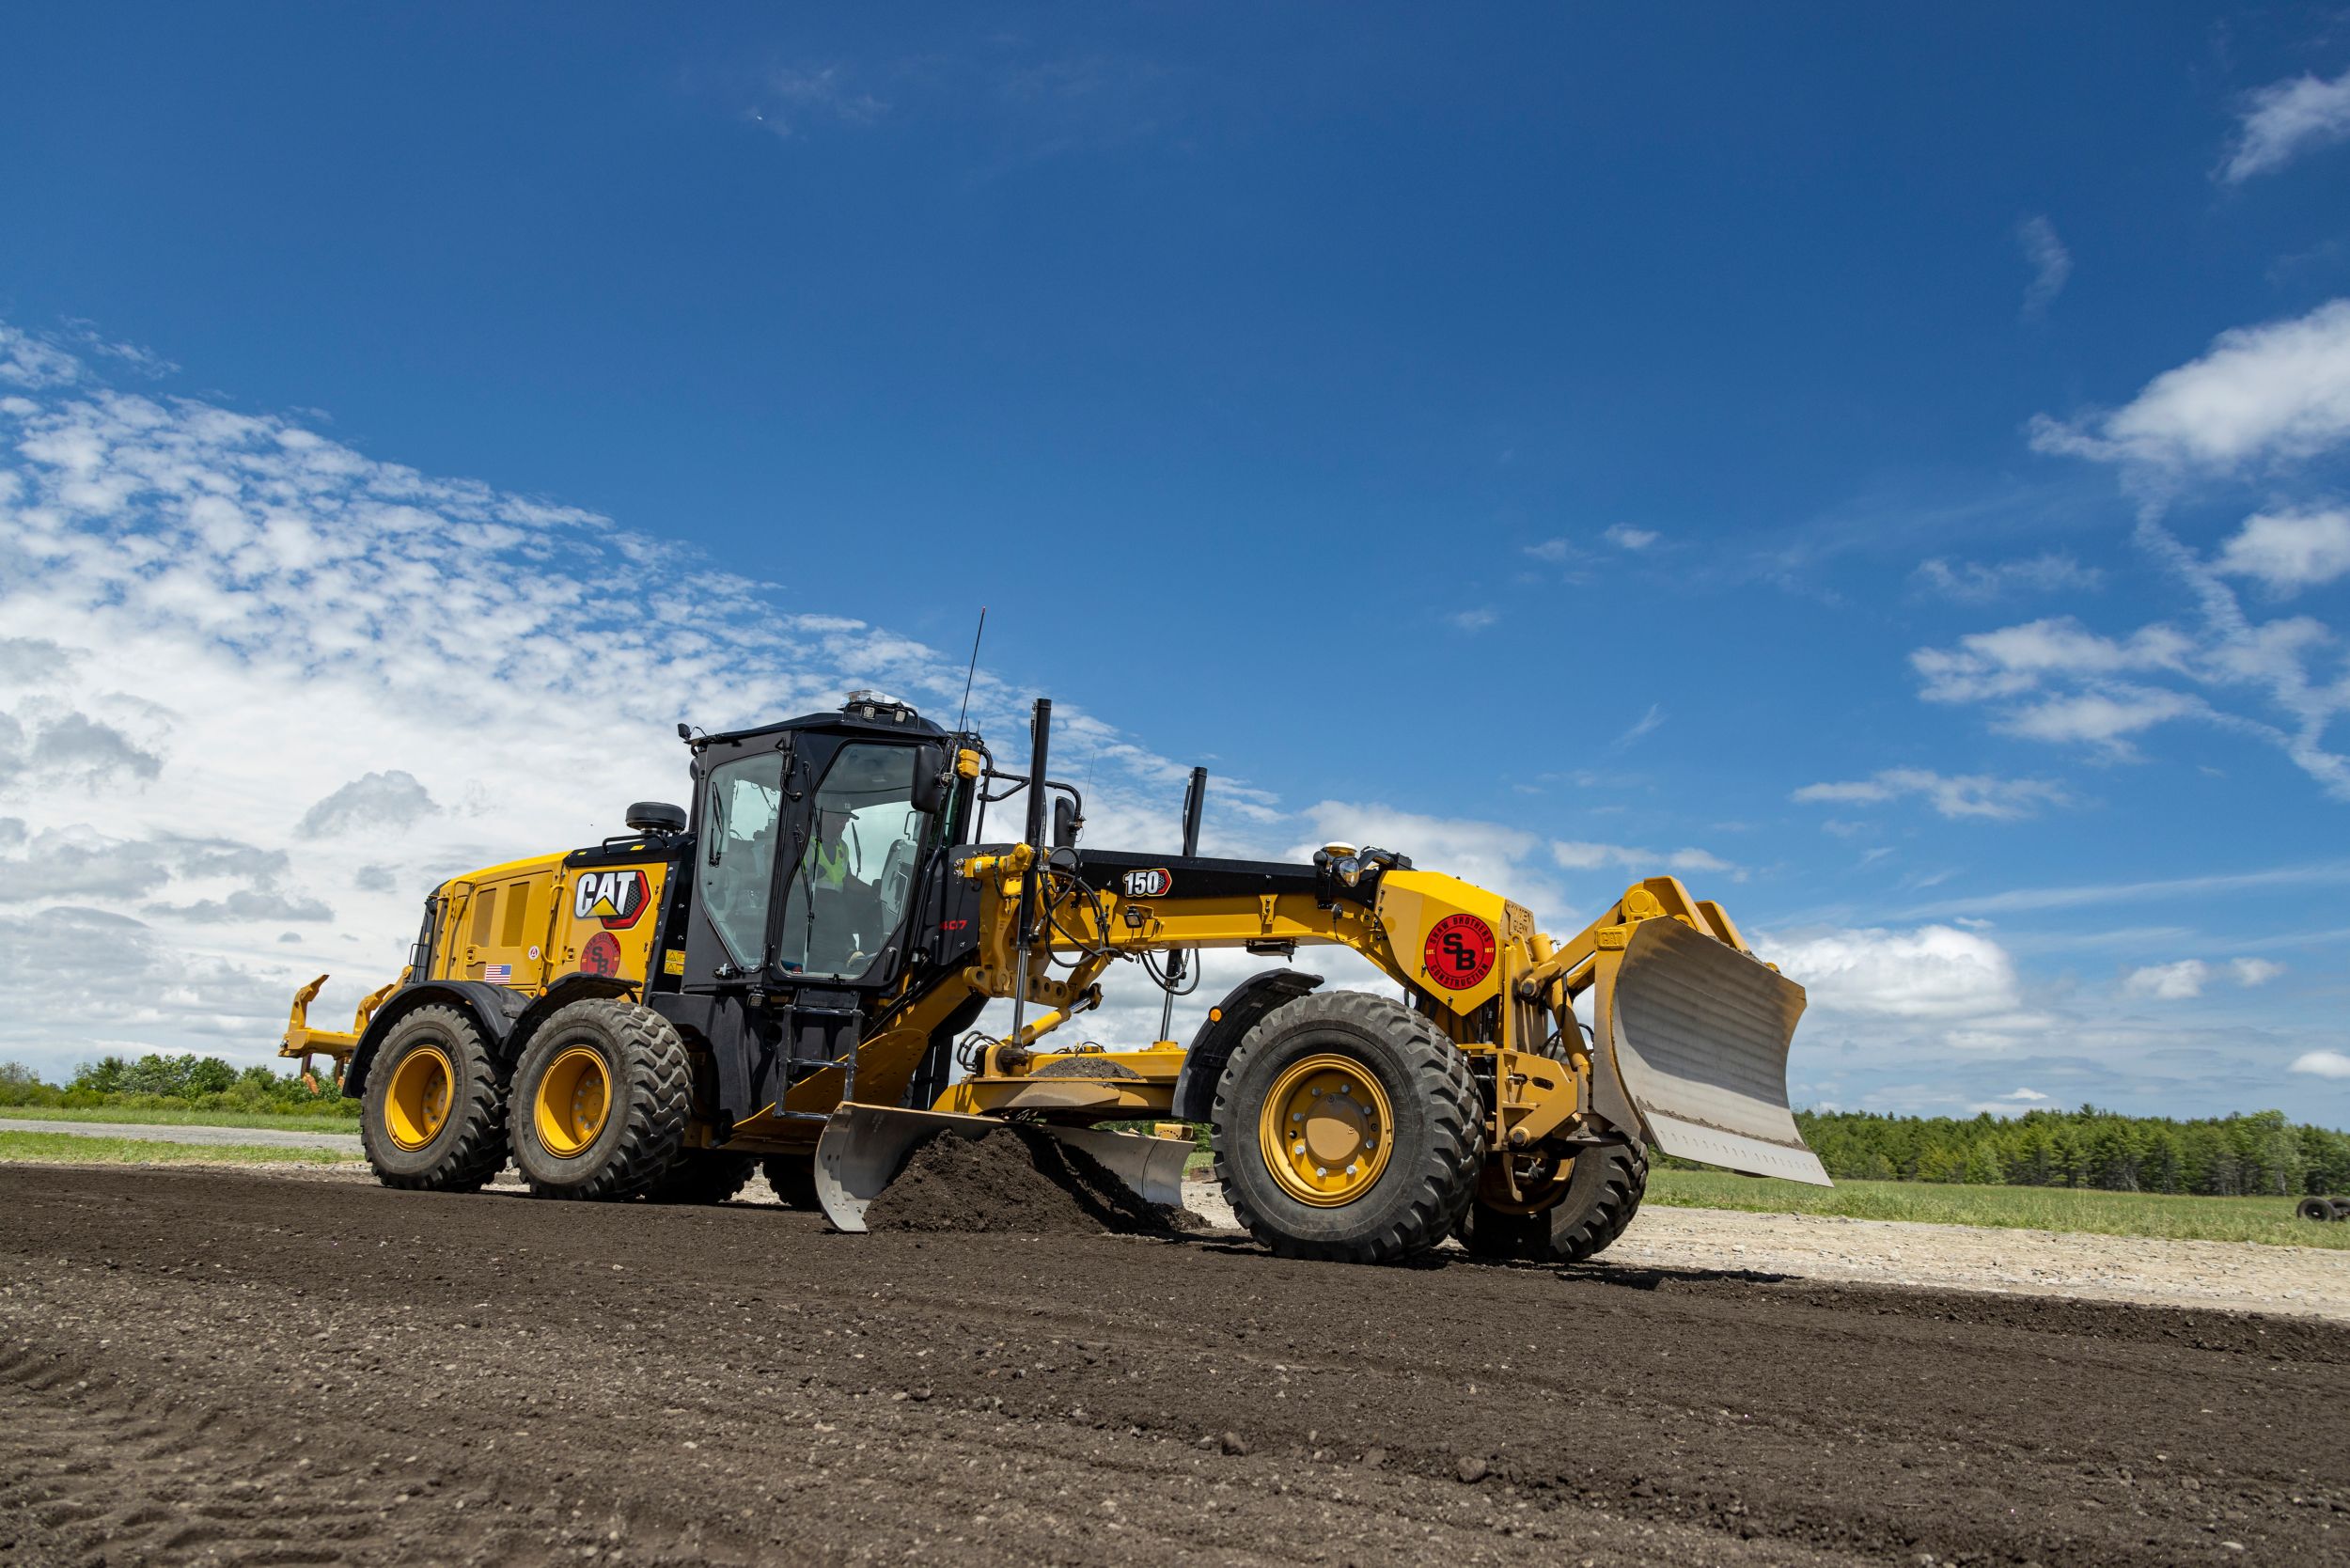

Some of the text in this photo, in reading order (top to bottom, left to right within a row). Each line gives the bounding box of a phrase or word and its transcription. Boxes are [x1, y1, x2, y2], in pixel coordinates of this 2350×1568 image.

[575, 871, 636, 917] CAT
[1125, 871, 1159, 895] 150
[938, 919, 968, 931] 407
[1430, 917, 1492, 944] SHAW BROTHERS
[1443, 933, 1476, 971] SB
[1430, 963, 1490, 987] CONSTRUCTION
